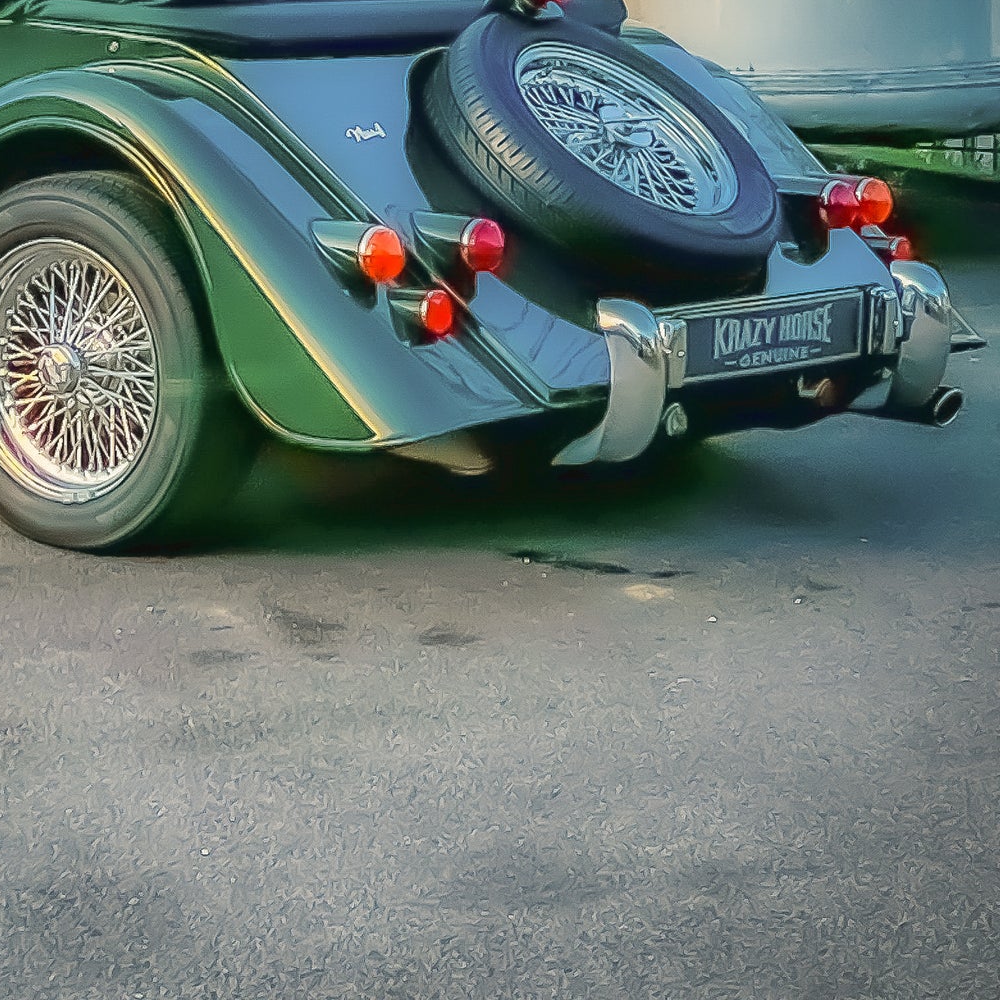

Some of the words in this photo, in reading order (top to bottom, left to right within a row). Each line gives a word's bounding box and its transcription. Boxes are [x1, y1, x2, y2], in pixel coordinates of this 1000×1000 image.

[713, 317, 777, 360] KRAZY
[779, 302, 834, 343] HORSE
[738, 345, 810, 368] GENUINE
